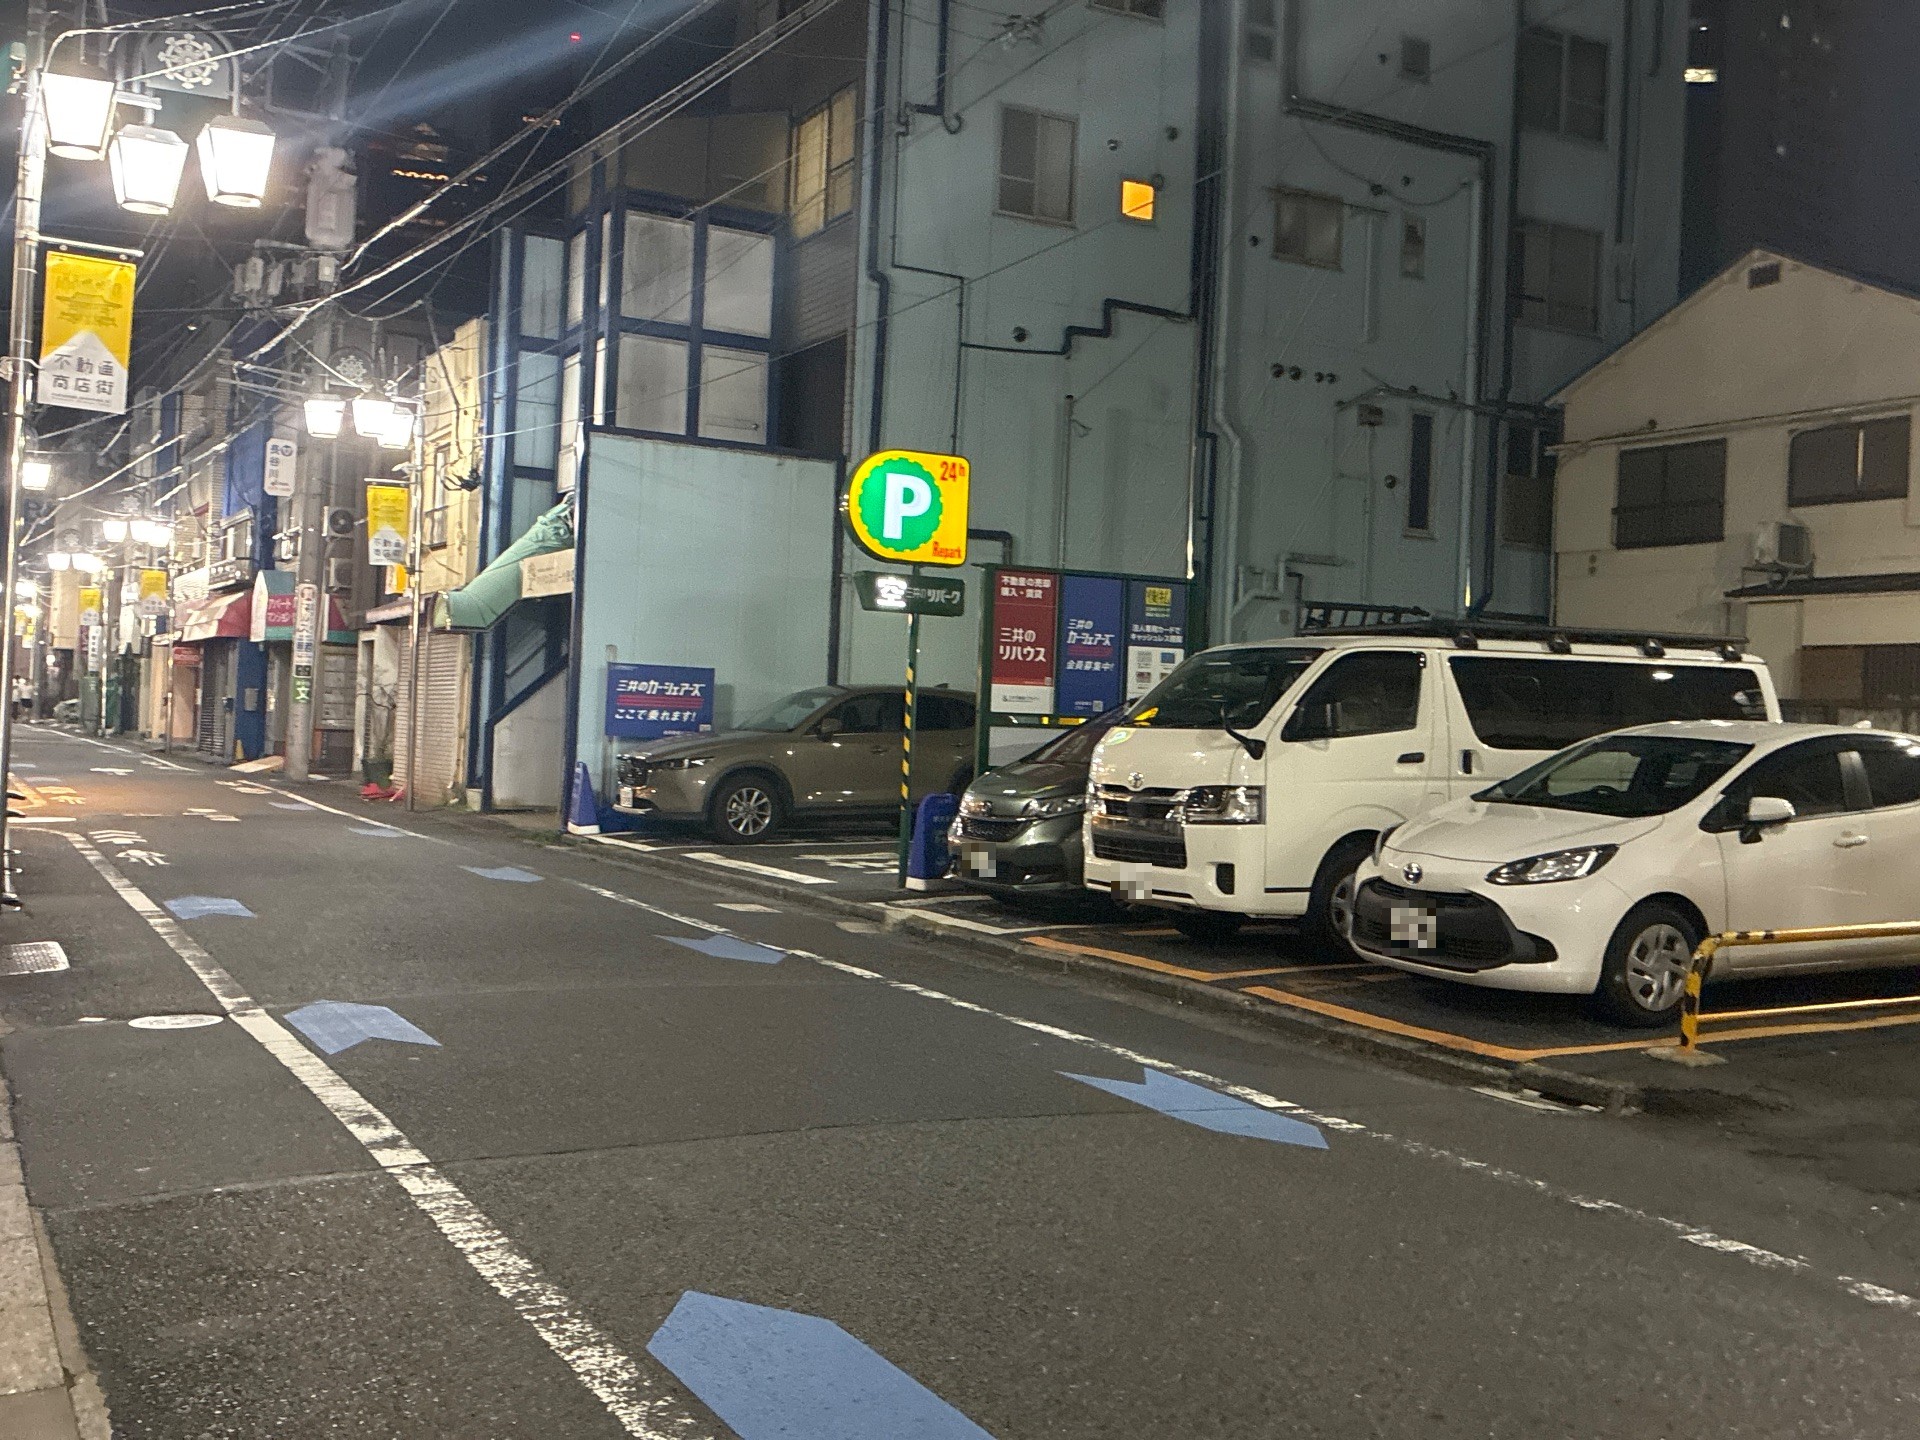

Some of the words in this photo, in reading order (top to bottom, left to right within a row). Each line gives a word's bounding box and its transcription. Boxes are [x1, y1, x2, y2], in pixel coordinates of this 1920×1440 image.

[53, 353, 115, 377] 不動通
[51, 374, 115, 396] 商店街
[882, 472, 932, 540] P
[1000, 627, 1037, 643] 三井の
[999, 645, 1047, 662] リハウス
